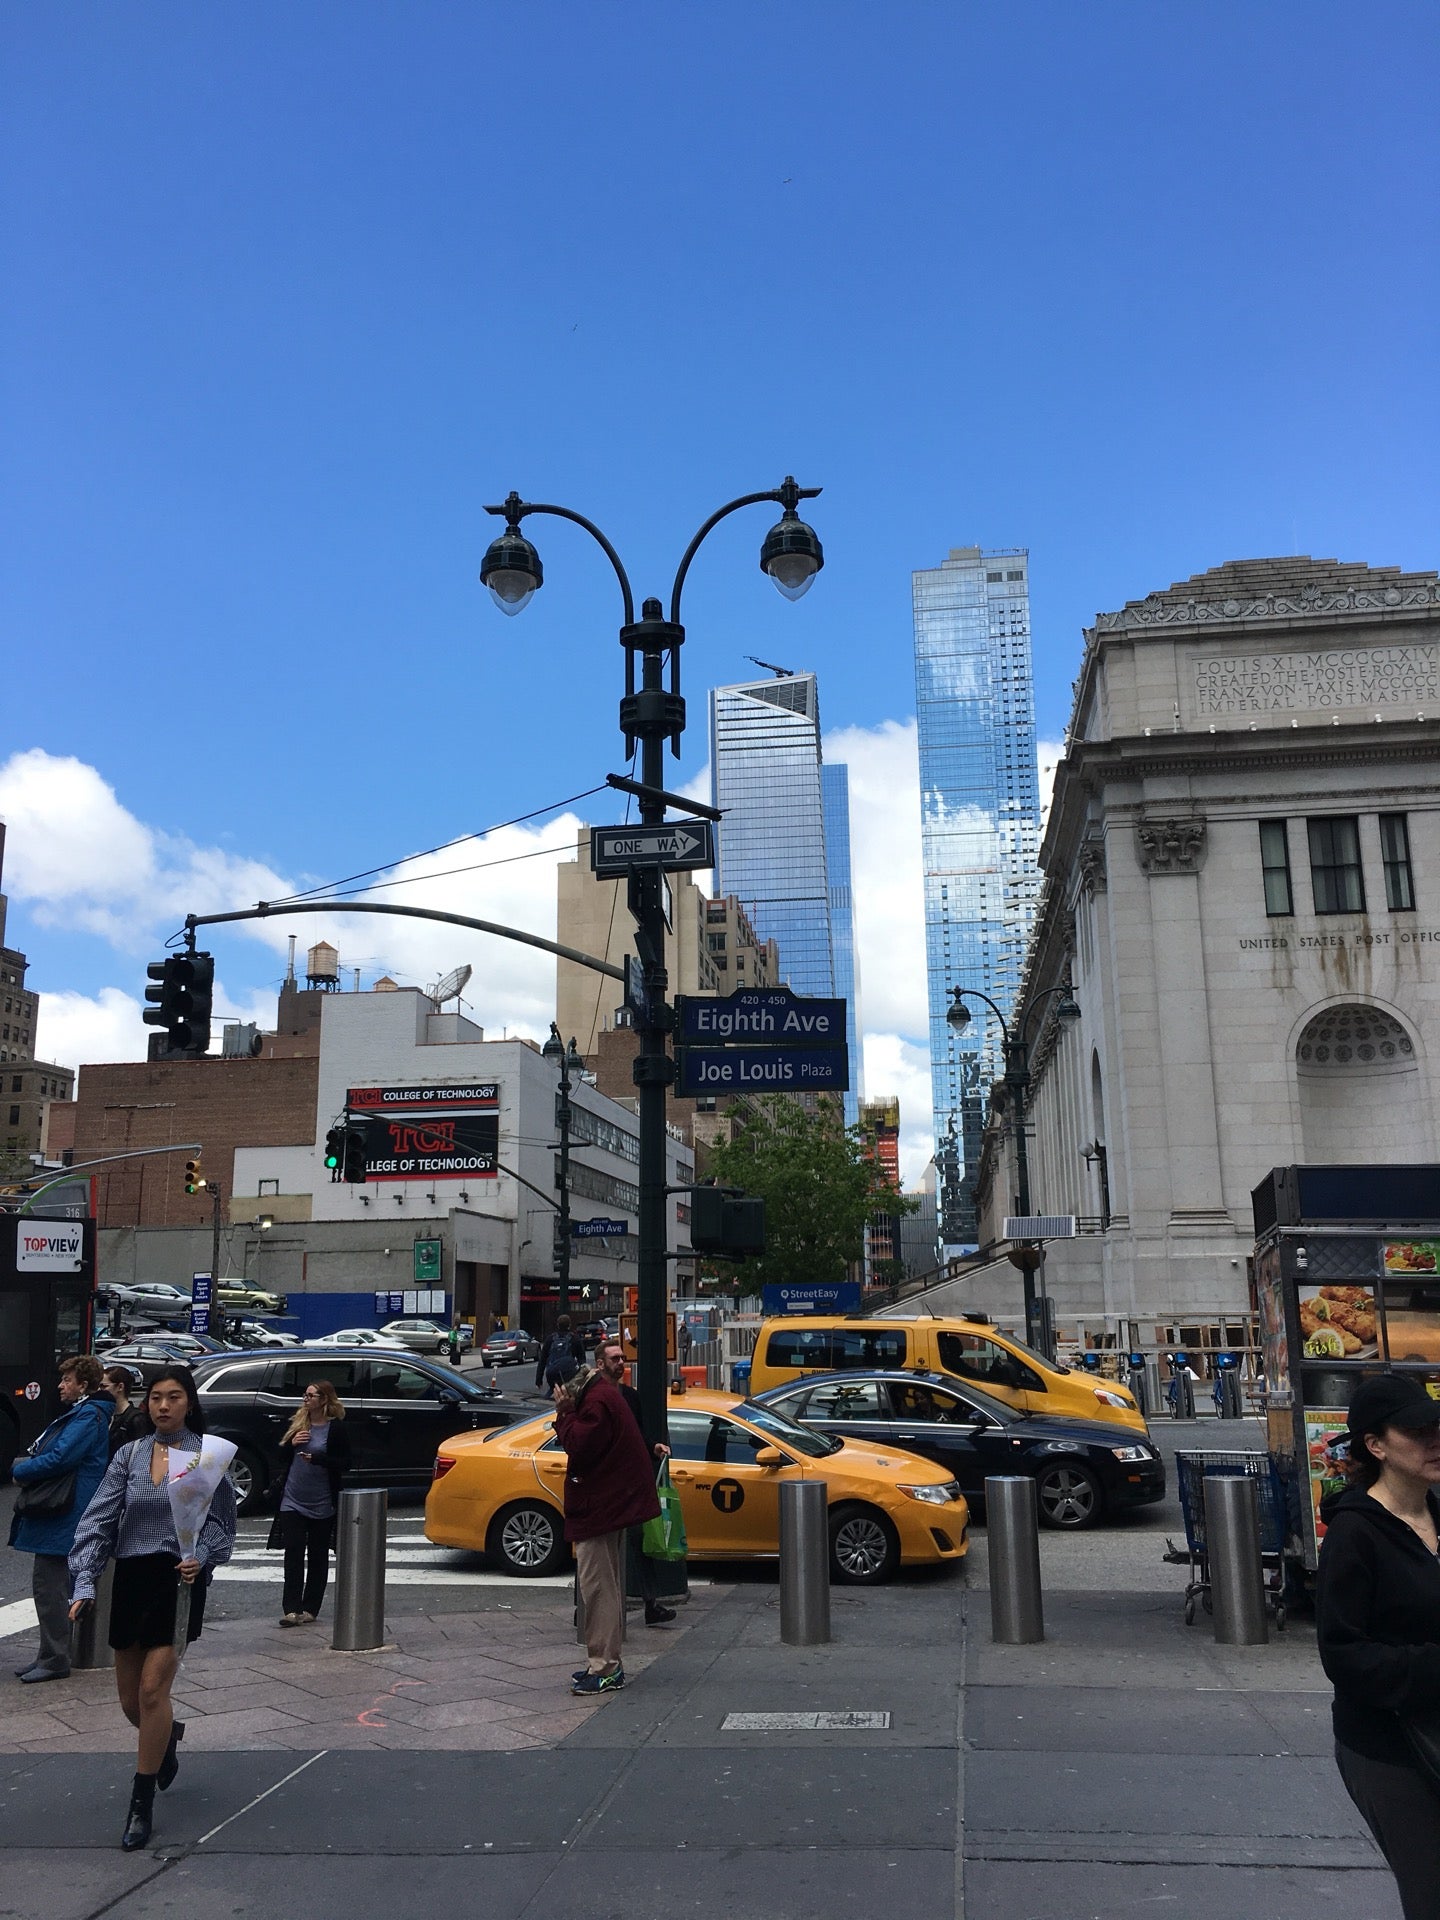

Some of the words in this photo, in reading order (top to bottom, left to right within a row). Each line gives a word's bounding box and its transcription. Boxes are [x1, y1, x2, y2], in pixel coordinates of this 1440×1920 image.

[1197, 659, 1262, 675] LOUIS
[1272, 656, 1294, 671] XI
[1307, 647, 1434, 668] MCCCCLXIV
[1196, 672, 1271, 689] CREATED
[1275, 669, 1309, 684] THE
[1315, 666, 1367, 681] POSTE
[1372, 661, 1437, 677] ROYALE
[1199, 686, 1256, 701] FRANZ
[1261, 684, 1296, 697] VON
[1303, 680, 1354, 694] TAXIS
[1200, 697, 1295, 714] IMPERIAL
[1307, 688, 1439, 707] POSTMASTER
[614, 840, 642, 854] ONE
[657, 837, 689, 851] WAY
[1239, 938, 1289, 949] UNITED
[1300, 935, 1345, 947] STATES
[1355, 933, 1390, 945] POST
[740, 995, 759, 1005] 420
[767, 996, 786, 1005] 450
[697, 1008, 774, 1036] Eighth
[782, 1010, 830, 1032] Ave
[699, 1060, 732, 1081] Joe
[740, 1058, 793, 1080] Louis
[801, 1064, 832, 1076] Plaza
[350, 1089, 381, 1104] TCI
[383, 1090, 421, 1101] COLLEGE
[424, 1090, 435, 1099] OF
[437, 1088, 495, 1099] TECHNOLOGY
[389, 1122, 455, 1153] TCI
[366, 1159, 397, 1171] LLEGE
[400, 1159, 415, 1170] OF
[65, 1207, 80, 1217] 316
[579, 1224, 605, 1235] Eighth
[606, 1224, 623, 1233] Ave
[24, 1237, 80, 1252] TOPVIEW
[790, 1289, 839, 1299] StreetEasy
[1305, 1336, 1339, 1356] Fish
[719, 1485, 737, 1508] T
